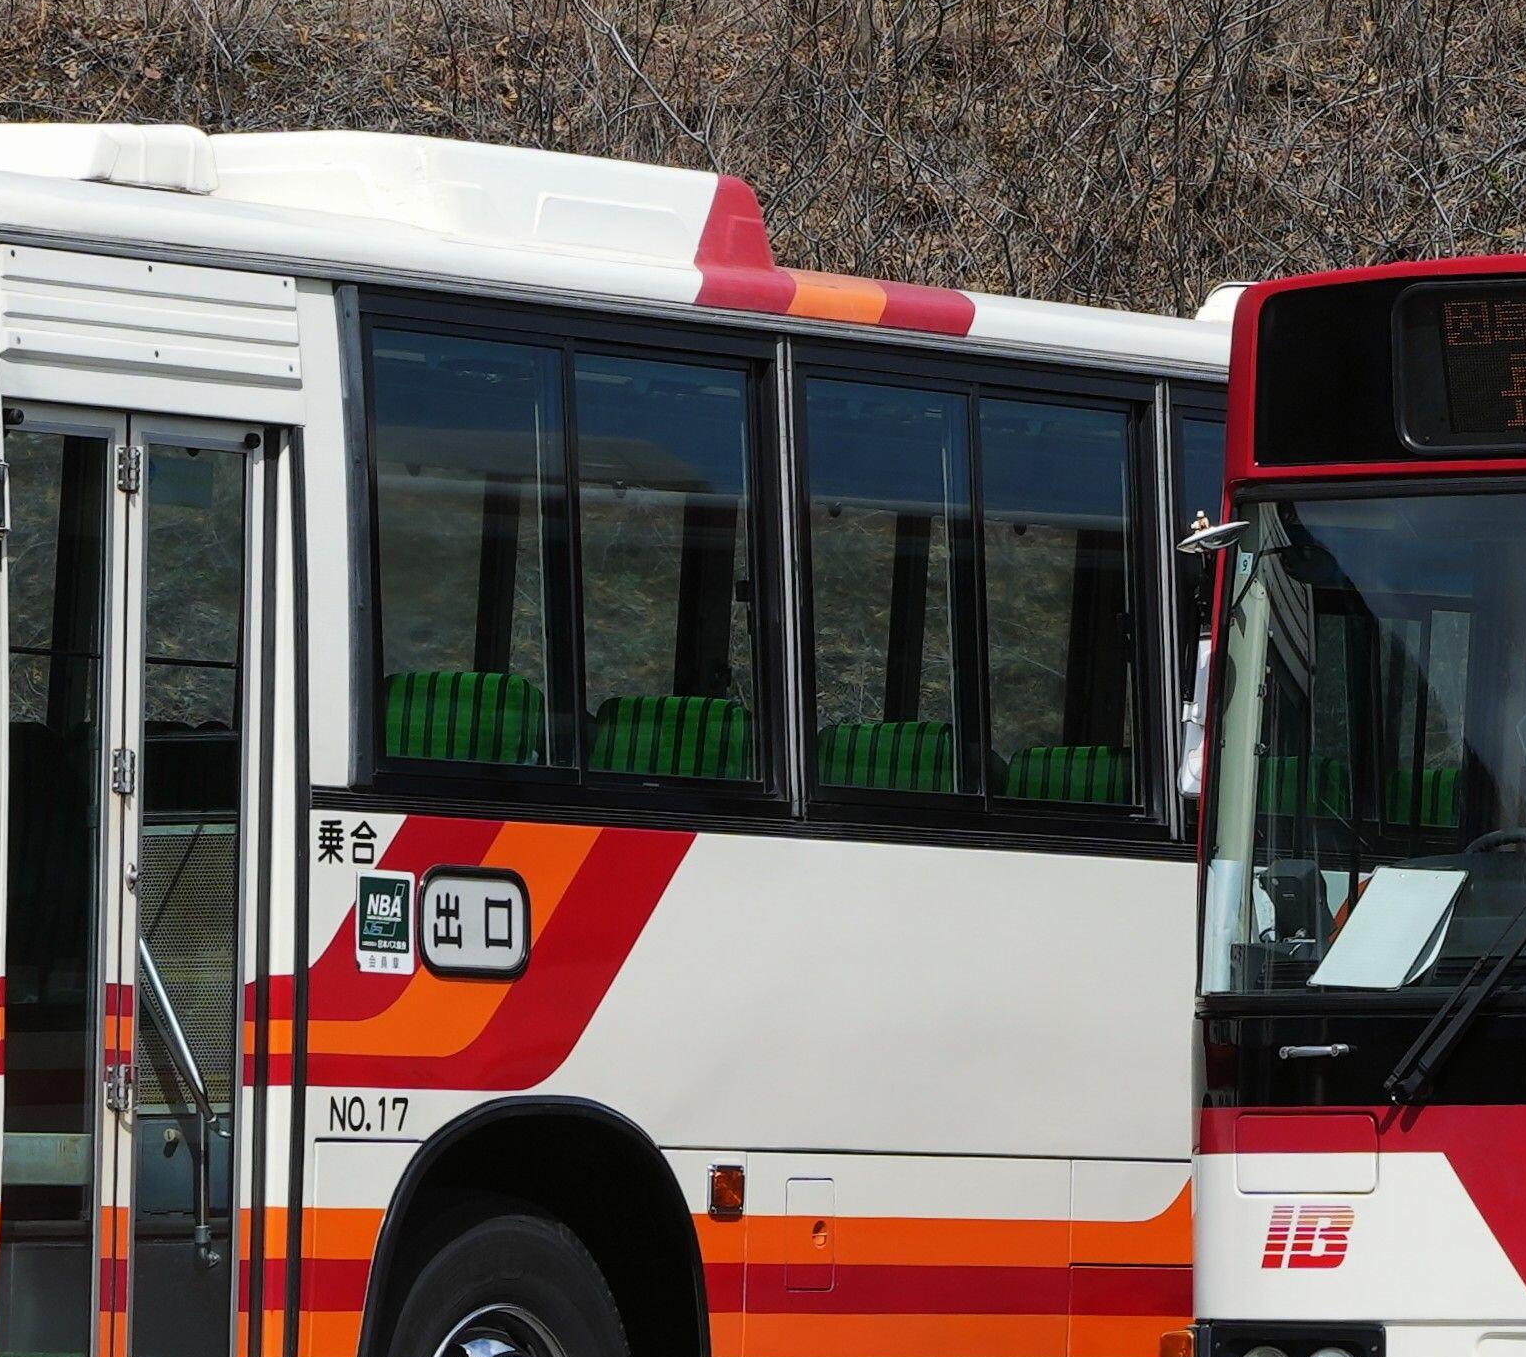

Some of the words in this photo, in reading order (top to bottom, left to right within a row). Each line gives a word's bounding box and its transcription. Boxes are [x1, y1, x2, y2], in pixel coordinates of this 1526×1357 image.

[318, 820, 377, 864] 乗合
[367, 893, 402, 918] NBA
[434, 893, 512, 949] 出口
[330, 1096, 409, 1132] NO.17
[1261, 1205, 1355, 1269] IB
